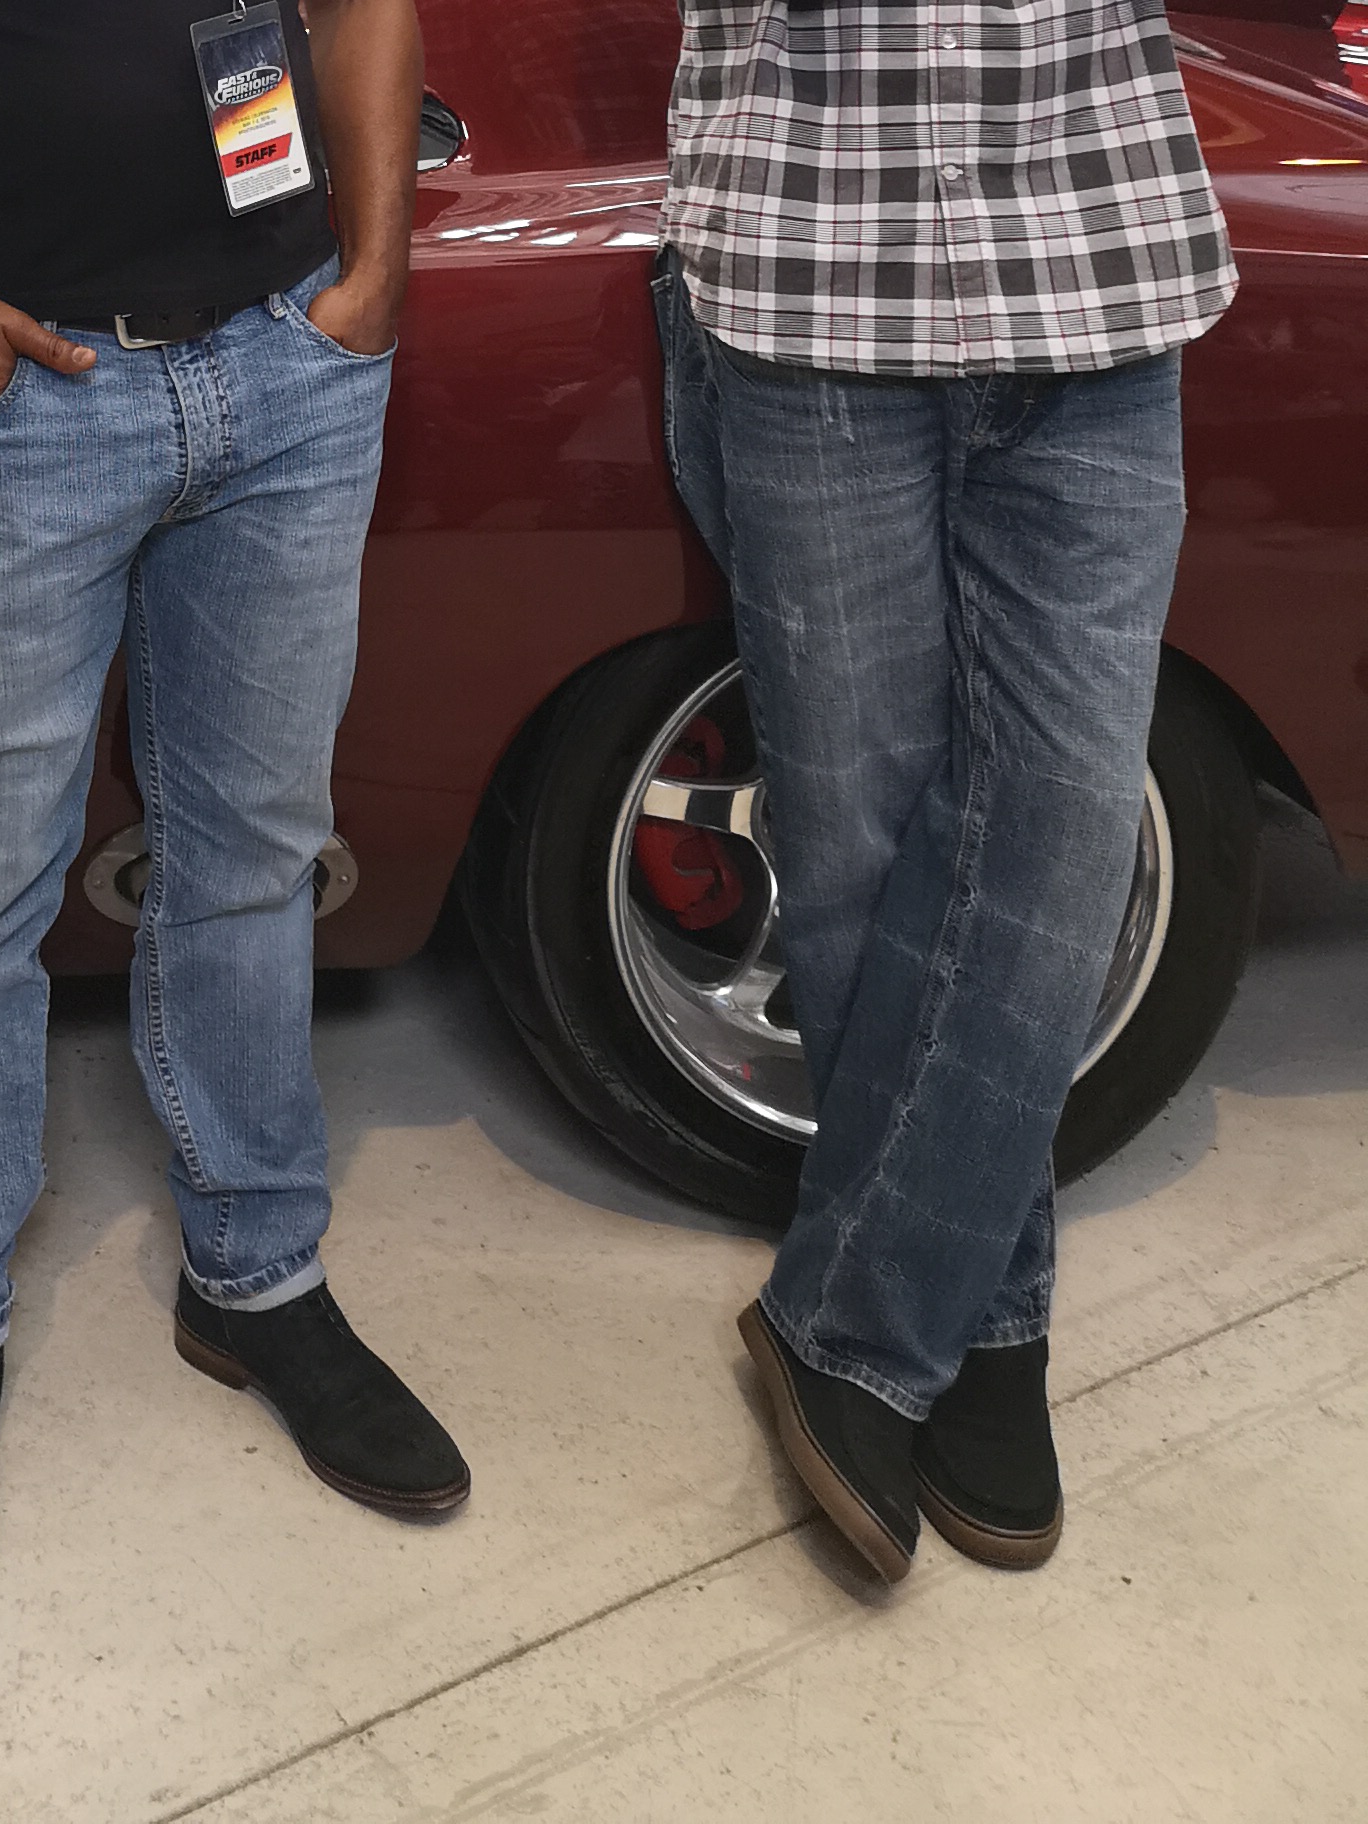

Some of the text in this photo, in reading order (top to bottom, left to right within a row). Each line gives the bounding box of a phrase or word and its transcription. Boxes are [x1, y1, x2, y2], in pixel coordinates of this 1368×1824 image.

[217, 72, 253, 92] FAST
[221, 73, 278, 104] FURIOUS
[235, 143, 277, 168] STAFF
